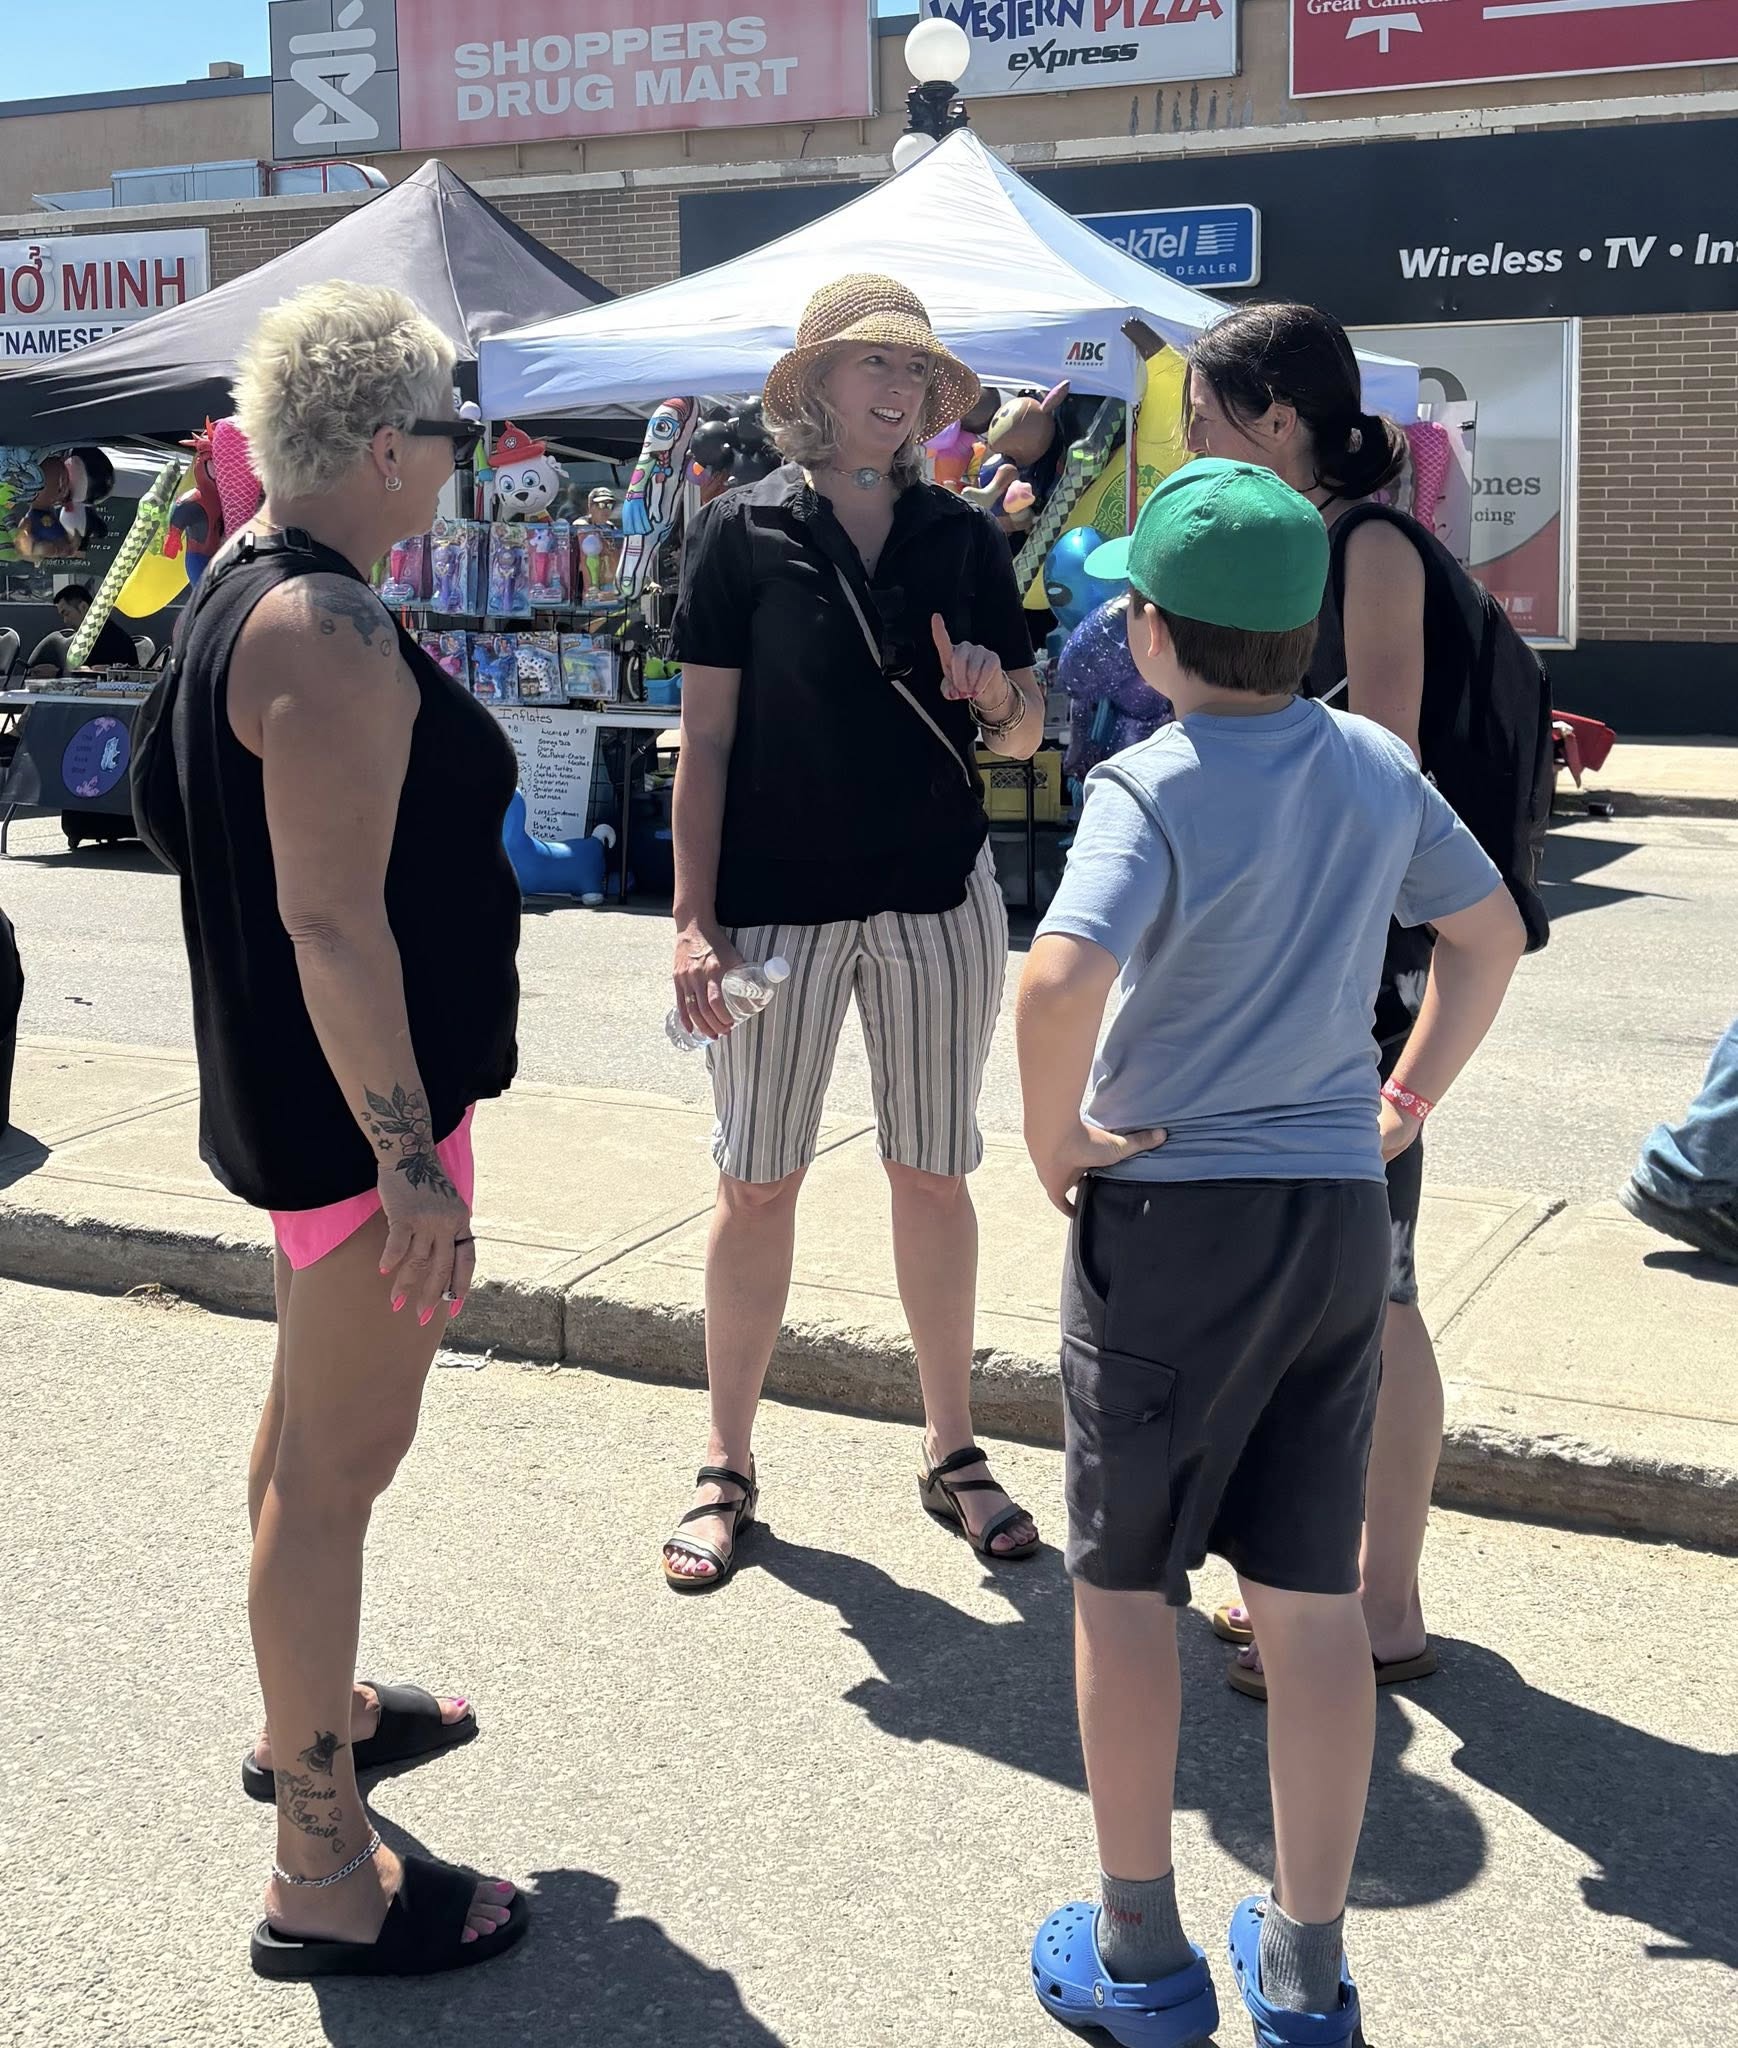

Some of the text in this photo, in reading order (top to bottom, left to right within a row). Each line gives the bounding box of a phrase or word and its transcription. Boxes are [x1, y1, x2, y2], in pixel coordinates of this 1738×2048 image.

[1092, 0, 1223, 32] PIZZA
[1307, 0, 1362, 14] Great
[454, 16, 767, 80] SHOPPERS
[457, 57, 798, 121] DRUG MART
[1176, 263, 1237, 276] DEALER
[1399, 233, 1738, 279] Wireless TV In
[0, 246, 186, 314] Ở MINH
[0, 327, 104, 355] NAMESE
[1066, 342, 1107, 361] ABC
[497, 708, 553, 724] Inflates
